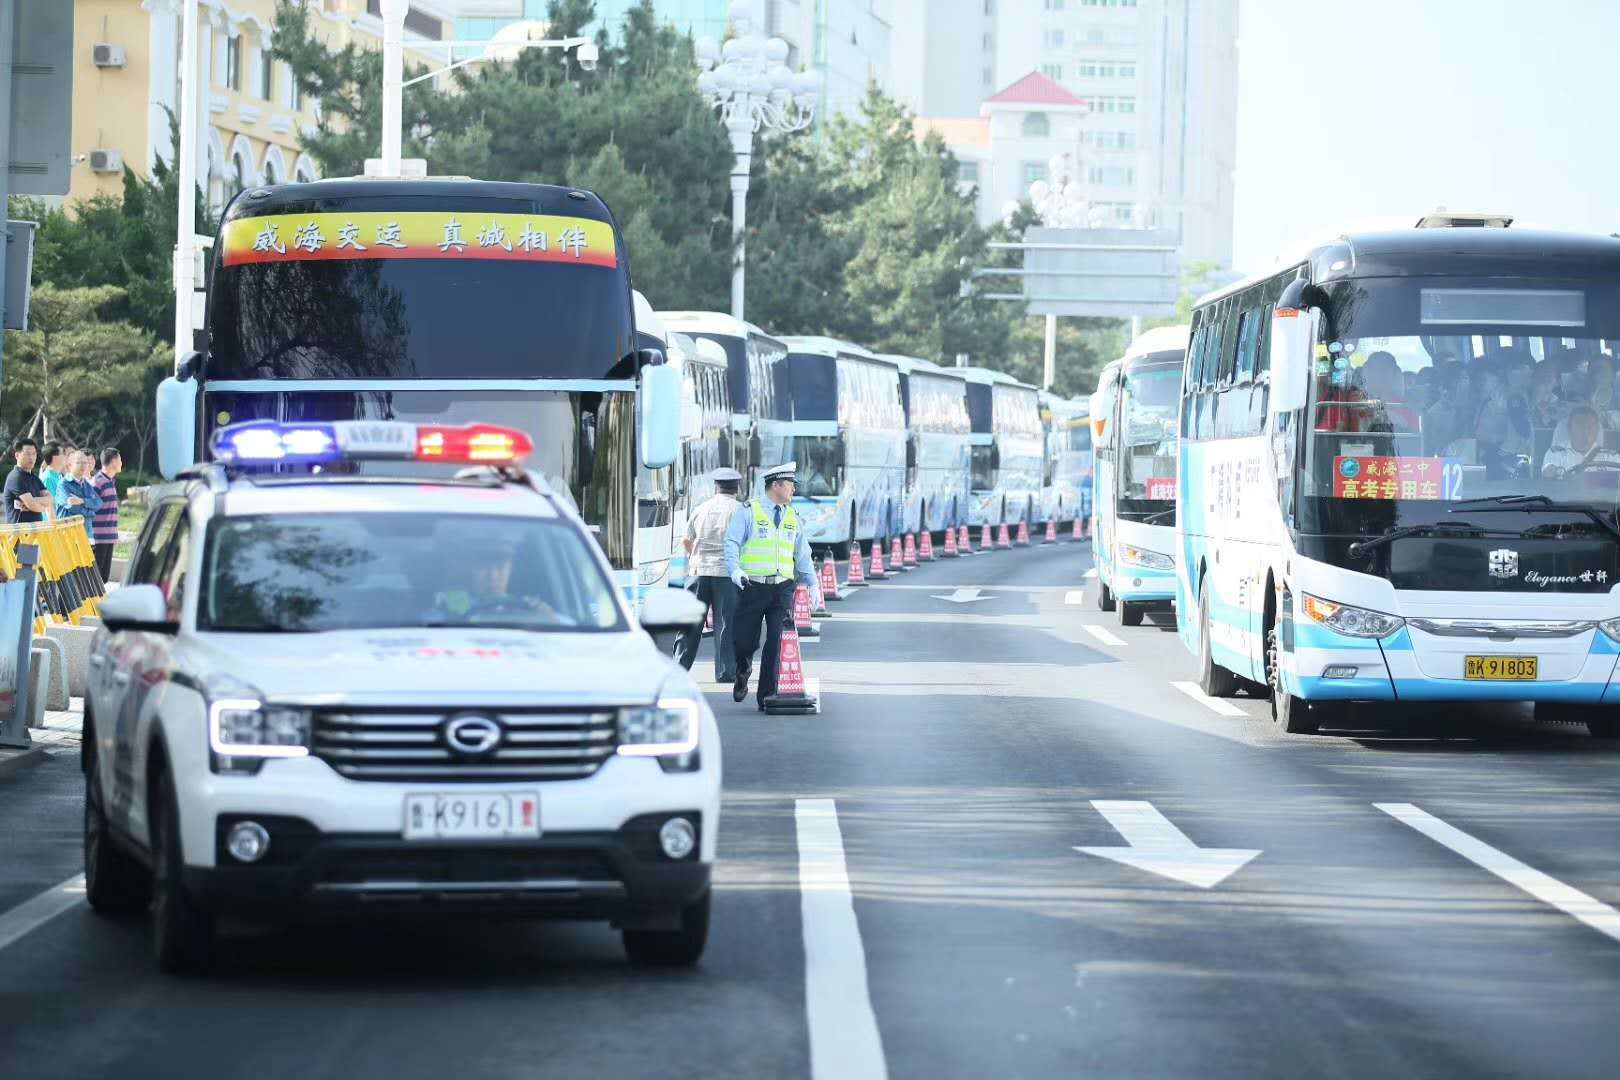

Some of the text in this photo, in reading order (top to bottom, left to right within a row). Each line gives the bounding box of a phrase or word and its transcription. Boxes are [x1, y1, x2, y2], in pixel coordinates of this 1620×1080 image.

[250, 220, 589, 258] 威海交运 真诚相伴
[1365, 460, 1431, 480] 威海二中
[1150, 482, 1177, 500] 威海交
[1342, 479, 1439, 500] 高考专用车
[1443, 463, 1463, 500] 12
[1524, 570, 1577, 587] Elegance
